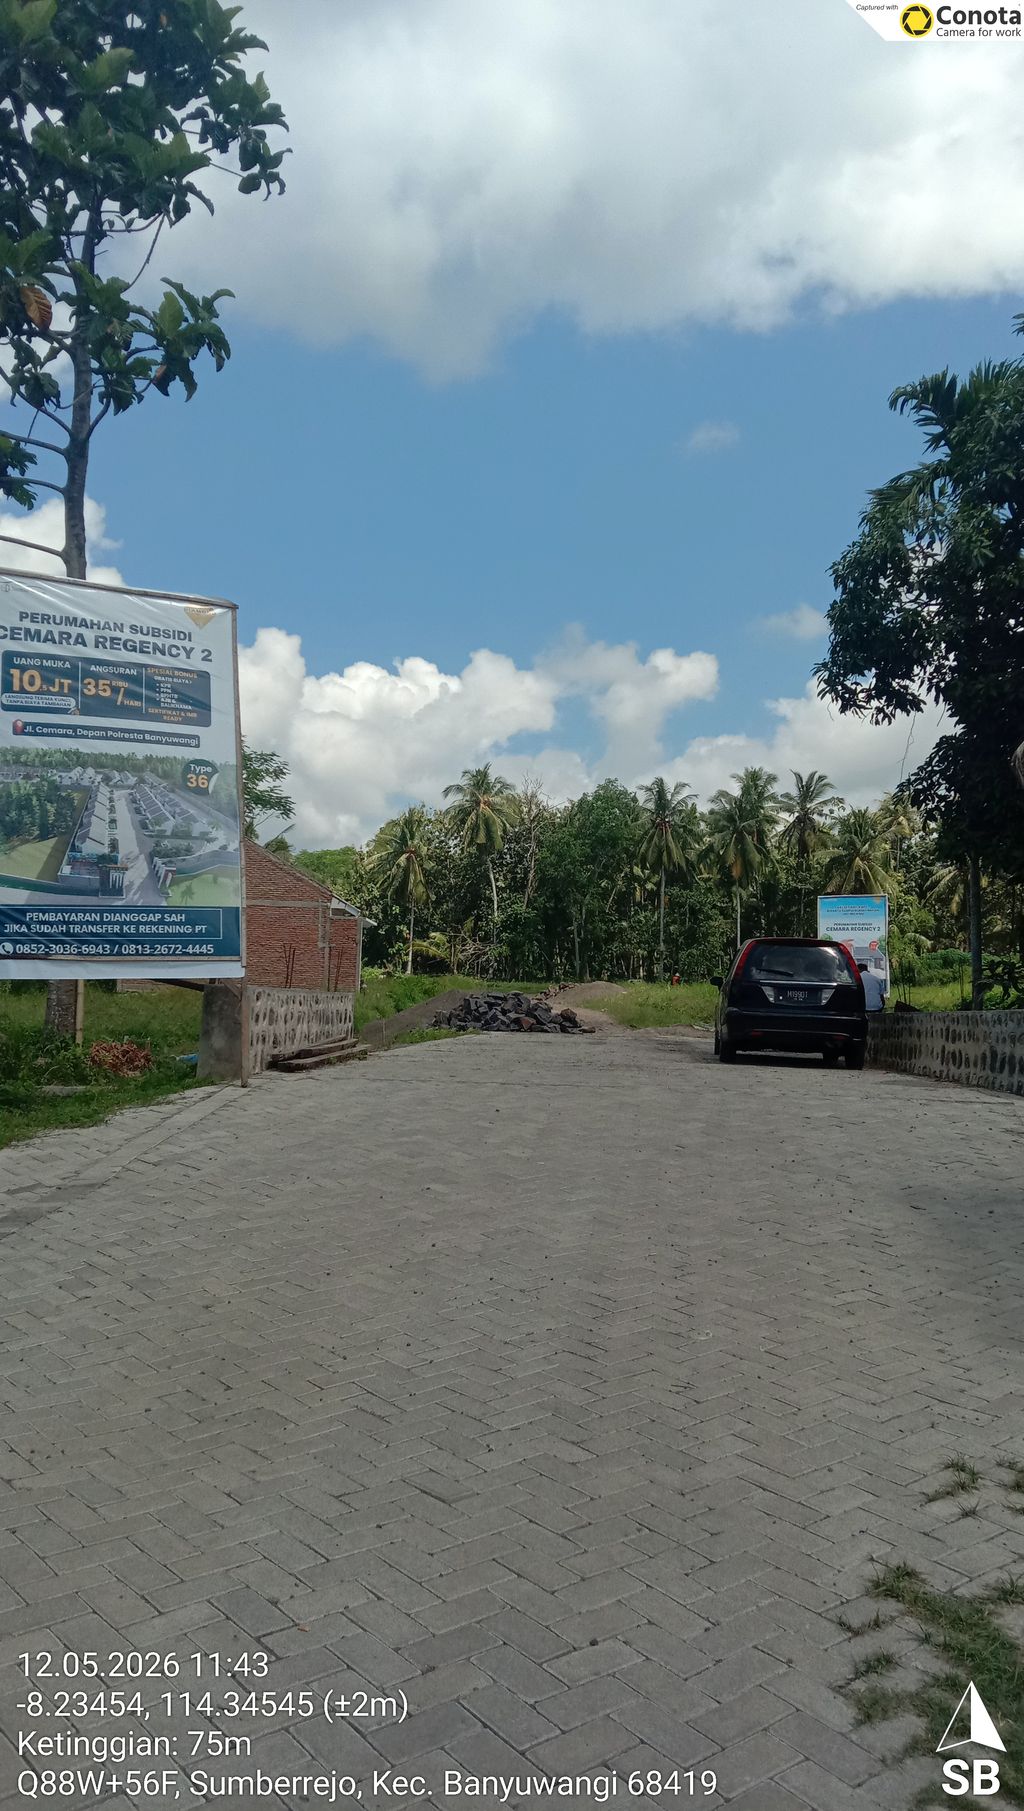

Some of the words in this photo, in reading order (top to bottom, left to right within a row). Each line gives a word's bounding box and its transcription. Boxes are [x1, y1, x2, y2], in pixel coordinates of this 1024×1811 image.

[19, 611, 124, 633] PERUMAHAN
[129, 624, 192, 642] SUBSIDI
[0, 625, 88, 648] CEMARA
[94, 635, 195, 660] REGENCY
[200, 648, 213, 662] 2
[13, 656, 41, 666] UANG
[42, 659, 71, 669] MUKA
[90, 664, 137, 676] ANGSURAN
[147, 667, 173, 676] SPESIAL
[48, 678, 72, 694] JT
[83, 677, 112, 697] 35
[24, 725, 35, 733] Jl.
[36, 725, 75, 738] Cemara,
[76, 727, 107, 739] Depan
[107, 729, 144, 741] Polresta
[144, 733, 198, 746] Banyuwangi
[189, 763, 212, 775] Type
[186, 774, 209, 789] 36
[26, 912, 101, 922] PEMBAYARAN
[103, 912, 162, 922] DIANGGAP
[164, 913, 185, 922] SAH
[4, 925, 28, 933] JIKA
[30, 925, 67, 933] SUDAH
[69, 925, 121, 933] TRANSFER
[123, 925, 136, 934] KE
[139, 925, 192, 934] REKENING
[195, 925, 207, 934] PT
[16, 944, 110, 954] 0852-3036-6943
[121, 944, 214, 954] 0813-2672-4445
